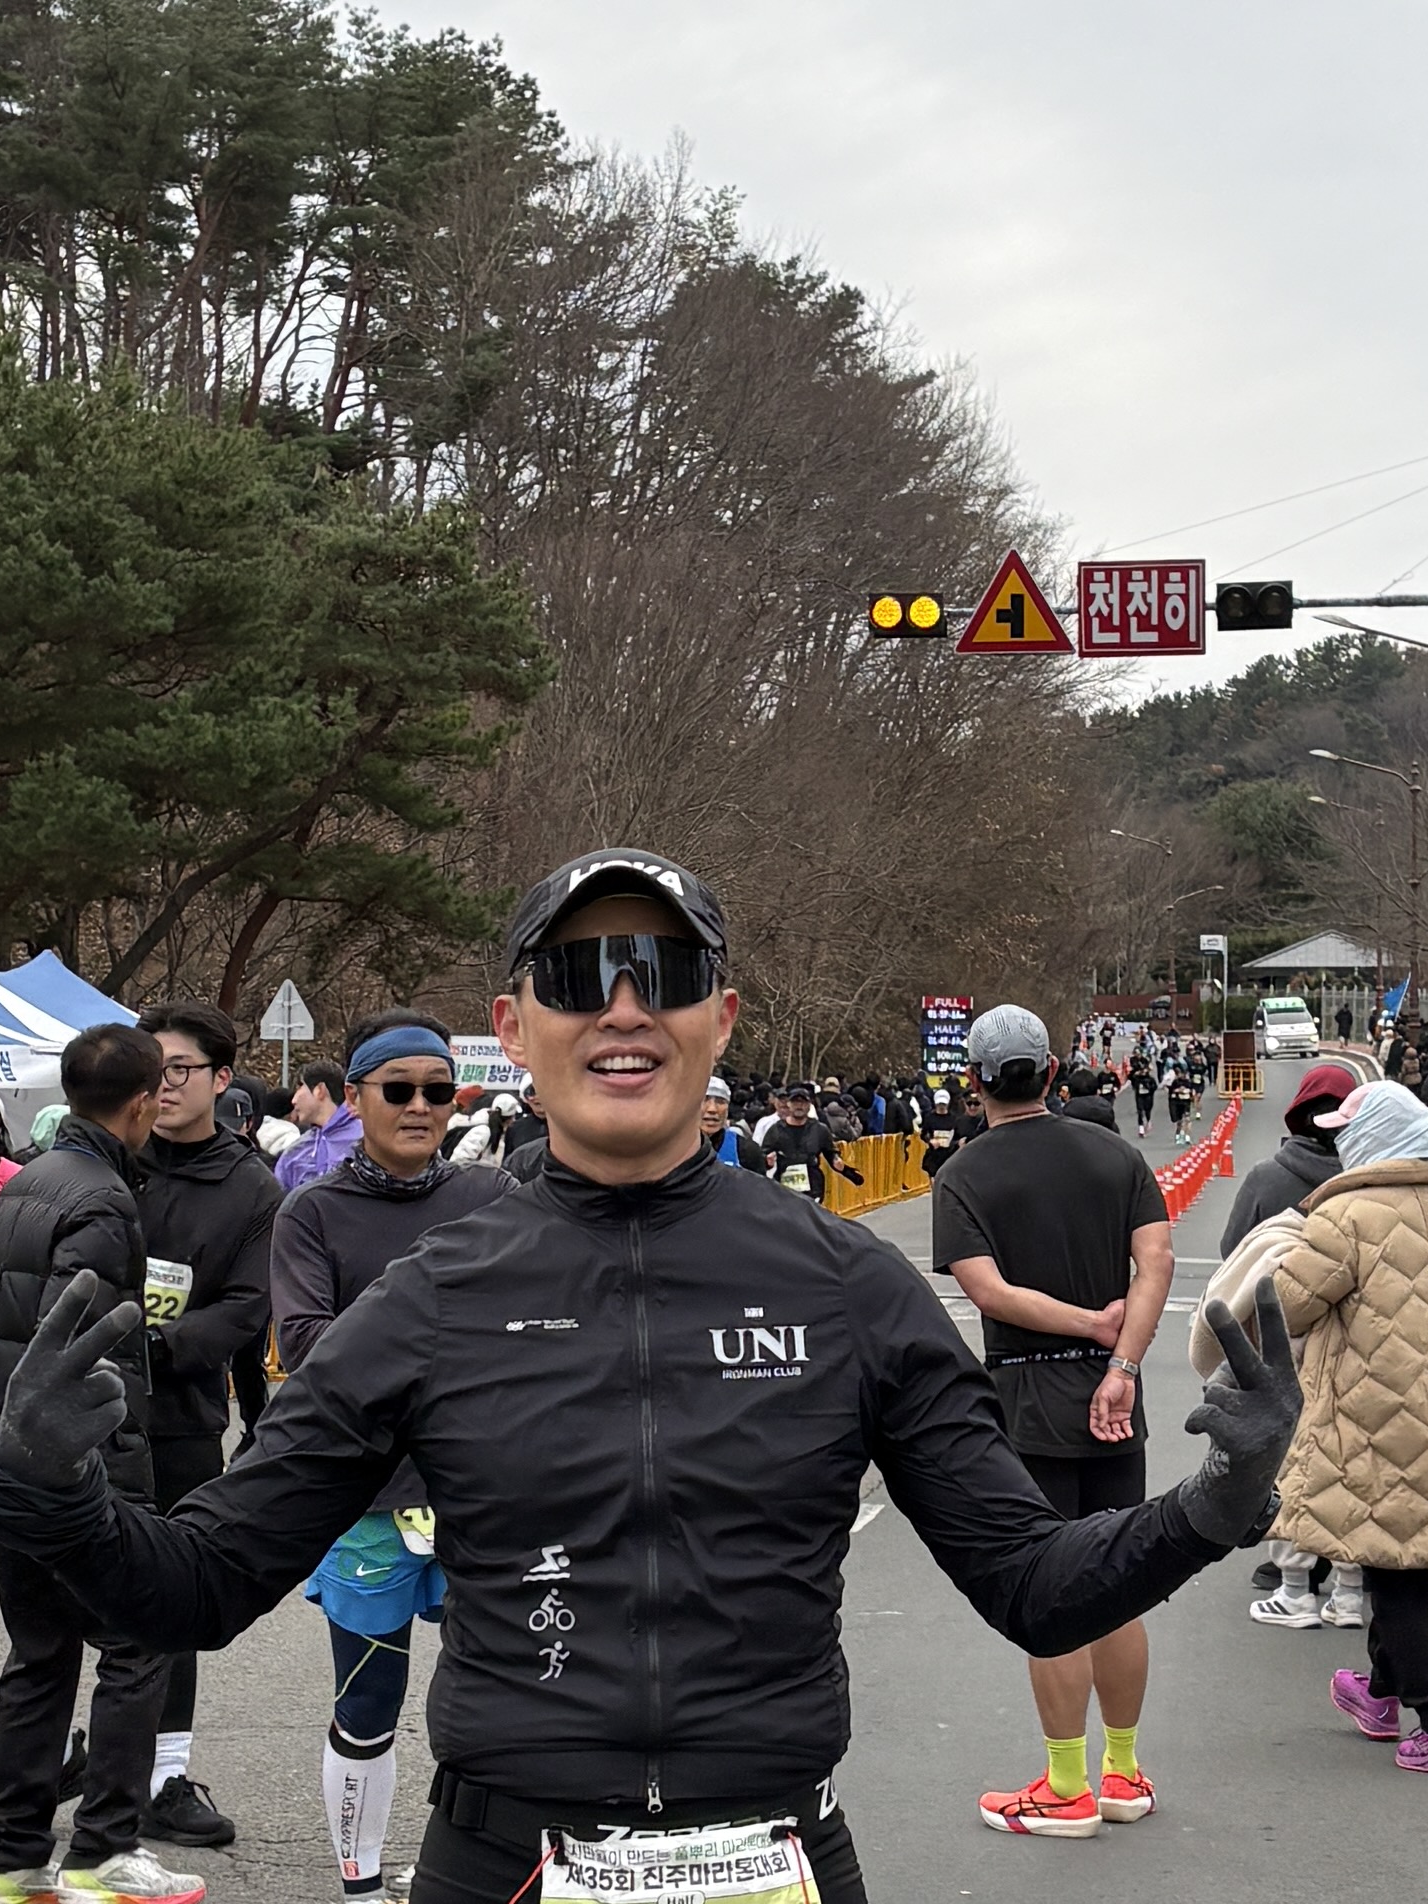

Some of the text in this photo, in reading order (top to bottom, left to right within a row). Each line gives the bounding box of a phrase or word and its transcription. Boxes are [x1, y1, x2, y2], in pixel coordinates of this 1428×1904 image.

[1088, 569, 1197, 644] 천천히
[568, 860, 684, 896] HA
[935, 998, 960, 1007] FULL
[934, 1025, 962, 1034] HALF
[709, 1325, 810, 1364] UNI
[722, 1366, 802, 1380] IRONMAN CLUB
[566, 1848, 791, 1892] 제35회 진주마라톤대회
